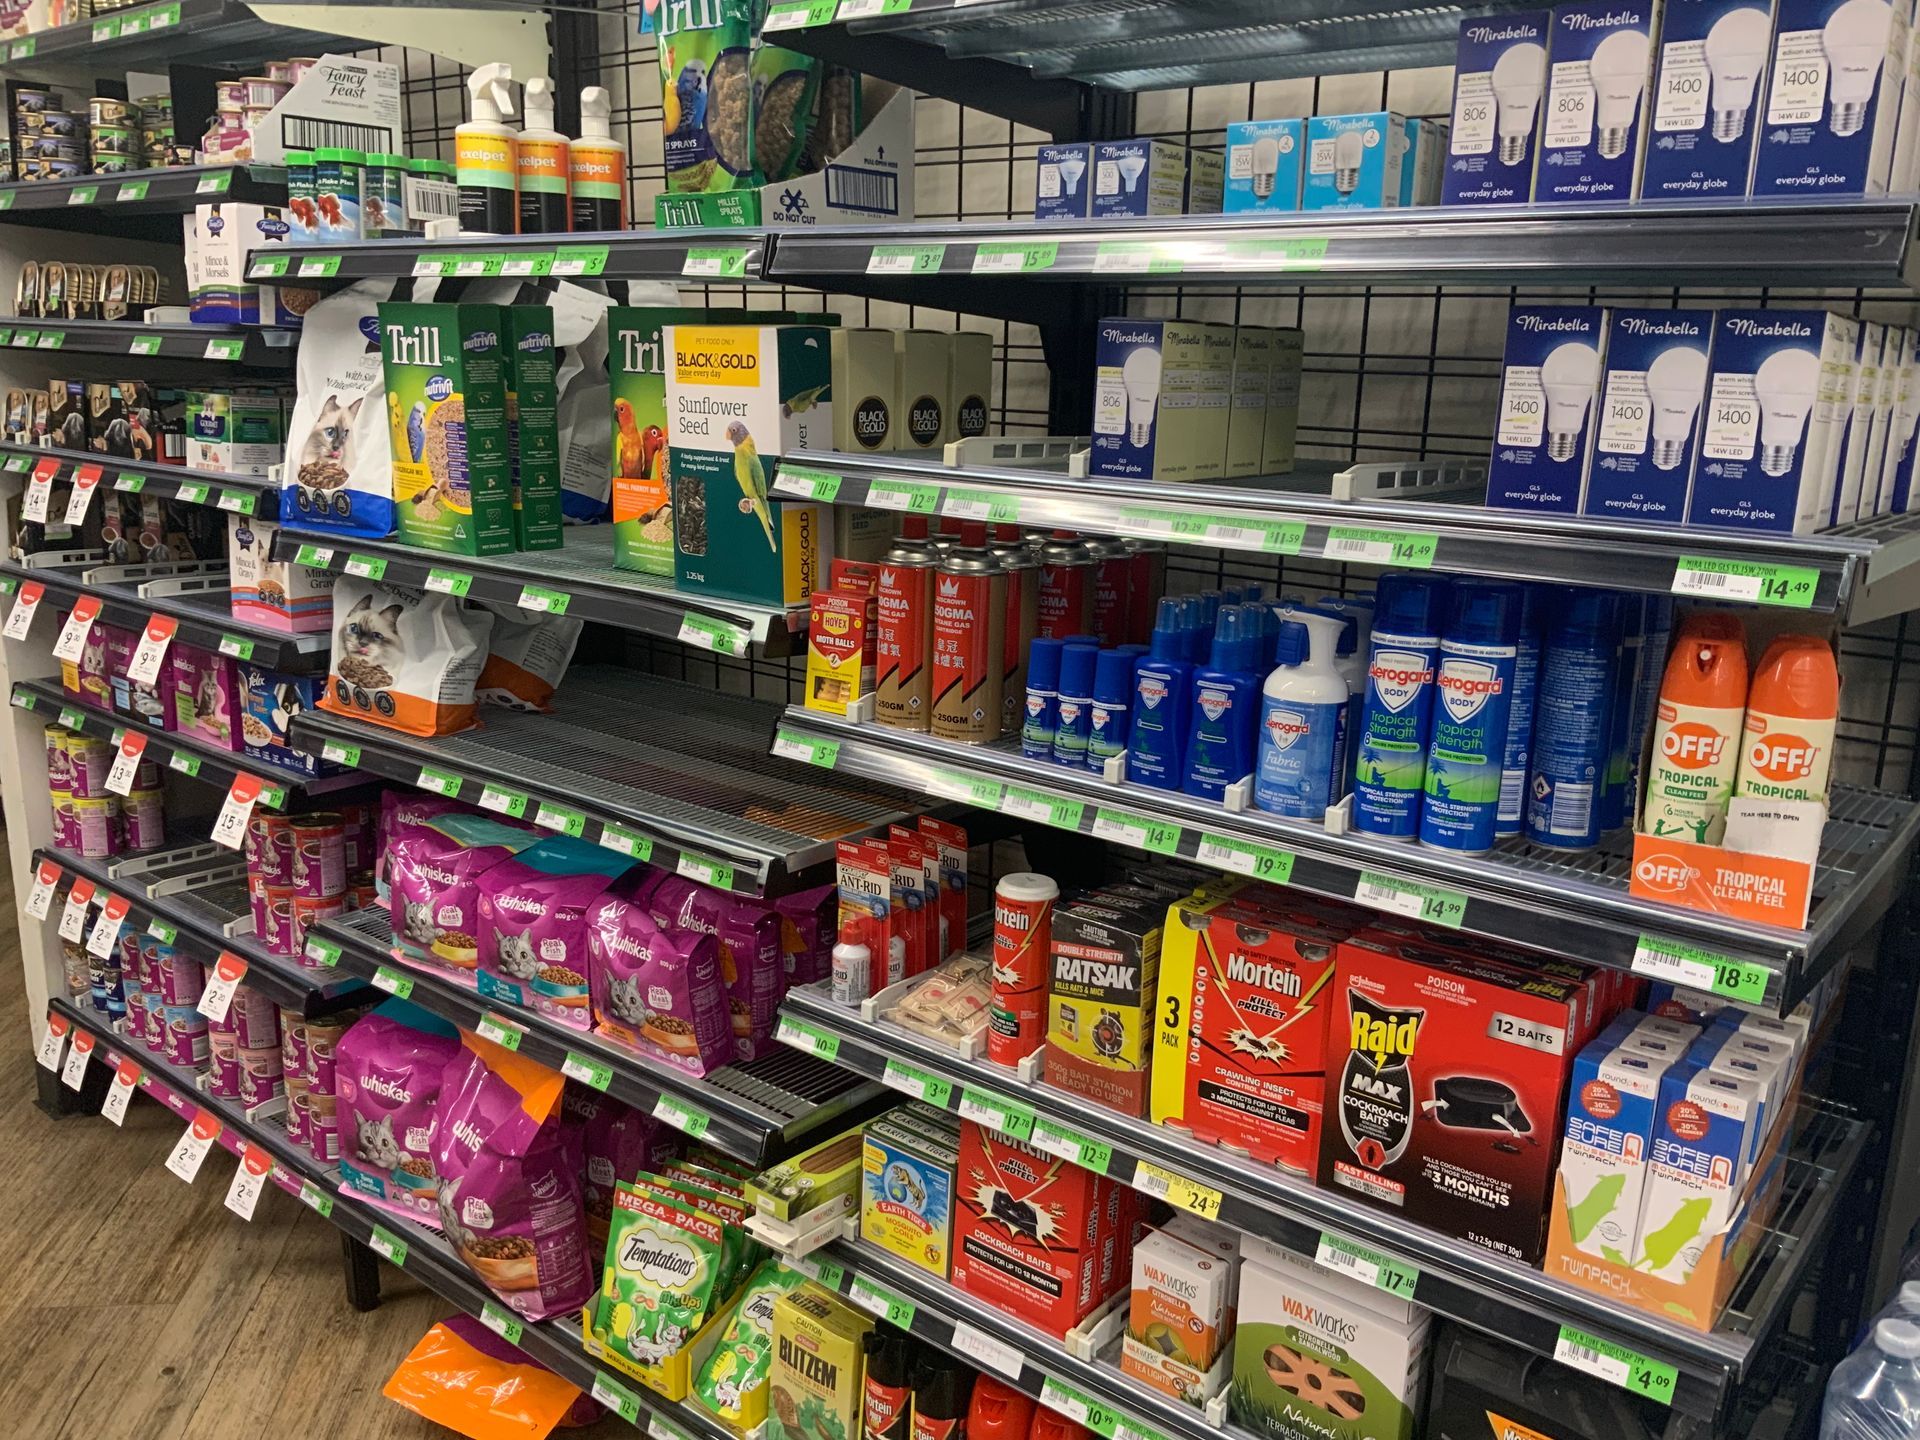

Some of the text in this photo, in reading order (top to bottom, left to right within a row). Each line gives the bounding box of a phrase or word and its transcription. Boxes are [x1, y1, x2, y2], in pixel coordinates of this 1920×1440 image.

[1562, 12, 1640, 30] Mirabella
[1467, 26, 1537, 42] Mirabella
[324, 66, 366, 86] Fancy
[1667, 78, 1701, 93] 1400
[1783, 70, 1819, 85] 1400
[329, 82, 366, 99] Feast
[1463, 107, 1487, 121] 806
[1558, 99, 1584, 113] 806
[1241, 123, 1289, 137] Mirabella
[1323, 118, 1374, 132] Mirabella
[1044, 147, 1082, 160] Mirabella
[1105, 146, 1143, 159] Mirabella
[1554, 182, 1613, 193] everyday globe
[1663, 179, 1727, 190] everyday globe
[1776, 174, 1846, 186] everyday globe
[1459, 187, 1513, 198] everyday globe
[662, 200, 705, 228] Trill
[773, 214, 815, 225] DO NOT CUT
[1516, 315, 1590, 332] Mirabella
[1620, 318, 1699, 336] Mirabella
[1726, 319, 1811, 337] Mirabella
[387, 325, 442, 366] Trill
[1103, 329, 1155, 344] Mirabella
[677, 352, 756, 370] BLACK&GOLD
[679, 396, 747, 417] Sunflower
[1103, 394, 1121, 408] 806
[1509, 401, 1539, 414] 1400
[859, 410, 885, 424] BLACK
[913, 409, 937, 421] BLACK
[1611, 406, 1643, 420] 1400
[1717, 410, 1751, 425] 1400
[679, 417, 709, 436] Seed
[1504, 492, 1561, 503] everyday globe
[1605, 500, 1666, 512] everyday globe
[1710, 507, 1775, 520] everyday globe
[1392, 542, 1430, 561] $14.49
[1761, 577, 1810, 599] $14.49
[1368, 663, 1433, 684] Aerogard
[1437, 672, 1502, 695] Aerogard
[1384, 688, 1409, 698] BODY
[1450, 697, 1475, 708] BODY
[878, 702, 904, 711] 250GM
[937, 714, 968, 724] 250GM
[1266, 719, 1309, 734] Aerogard
[1371, 711, 1417, 728] Tropical
[1437, 720, 1484, 738] Tropical
[1369, 722, 1416, 739] Strength
[1436, 731, 1483, 750] Strength
[1661, 730, 1727, 765] OFF!
[1265, 752, 1300, 768] Fabric
[1749, 741, 1817, 777] OFF!
[1658, 768, 1719, 788] TROPICAL
[1666, 787, 1706, 800] CLEAN FEEL
[1746, 779, 1810, 800] TROPICAL
[1147, 827, 1175, 845] $14.51
[413, 863, 461, 886] whiskas
[1636, 862, 1690, 890] OFF!
[1715, 868, 1787, 896] TROPICAL
[840, 877, 882, 895] ANT-RID
[498, 894, 547, 917] whiskas
[1713, 885, 1785, 909] CLEAN FEEL
[1423, 897, 1461, 918] $14.99
[1082, 924, 1108, 938] CAUTION
[610, 935, 653, 963] whiskas
[1057, 944, 1123, 962] DOUBLE STRENGTH
[1055, 957, 1134, 991] RATSAK
[1226, 953, 1303, 998] Mortein
[1714, 964, 1759, 988] $18.52
[1054, 982, 1069, 990] KILLS
[1069, 983, 1084, 993] RATS
[1090, 986, 1104, 997] MICE
[1427, 975, 1465, 995] POISON
[1164, 996, 1180, 1030] 3
[1236, 999, 1286, 1020] PROTECT
[1162, 1032, 1179, 1049] PACK
[1350, 1011, 1419, 1056] Raid
[1496, 1018, 1553, 1045] 12 BAITS
[360, 1074, 413, 1104] whiskas
[1215, 1066, 1295, 1097] CRAWLING INSECT
[1225, 1078, 1283, 1101] CONTROL BOMB
[1351, 1073, 1402, 1103] MAX
[1344, 1094, 1408, 1124] COCKROACH
[1359, 1110, 1389, 1127] BAITS
[1568, 1127, 1622, 1151] SURE
[1570, 1117, 1622, 1141] SAFE
[1082, 1142, 1108, 1164] $12.52
[1654, 1138, 1710, 1163] SAFE
[999, 1160, 1039, 1184] PROTECT
[1652, 1150, 1709, 1177] SURE
[1337, 1162, 1401, 1192] FAST KILLING
[1432, 1171, 1510, 1207] 3 MONTHS
[1187, 1190, 1220, 1213] $24.37
[881, 1202, 928, 1231] EARTH TIGER
[885, 1216, 922, 1239] MOSQUITO
[893, 1225, 914, 1242] COILS
[1468, 1231, 1474, 1239] 12
[623, 1238, 696, 1276] Temptations
[974, 1229, 1052, 1271] COCKROACH BAITS
[1382, 1268, 1415, 1291] $17.18
[1561, 1255, 1631, 1293] TWINPACK
[1152, 1288, 1187, 1310] CITROBELLA
[795, 1316, 823, 1336] CAUTION
[1298, 1330, 1337, 1354] CITROBELLA
[1299, 1336, 1341, 1363] SANDALWOOD
[778, 1334, 838, 1391] BLITZEM
[1134, 1364, 1171, 1388] TEA LIGHTS
[1635, 1367, 1670, 1390] $4.09
[1283, 1403, 1337, 1440] Natural
